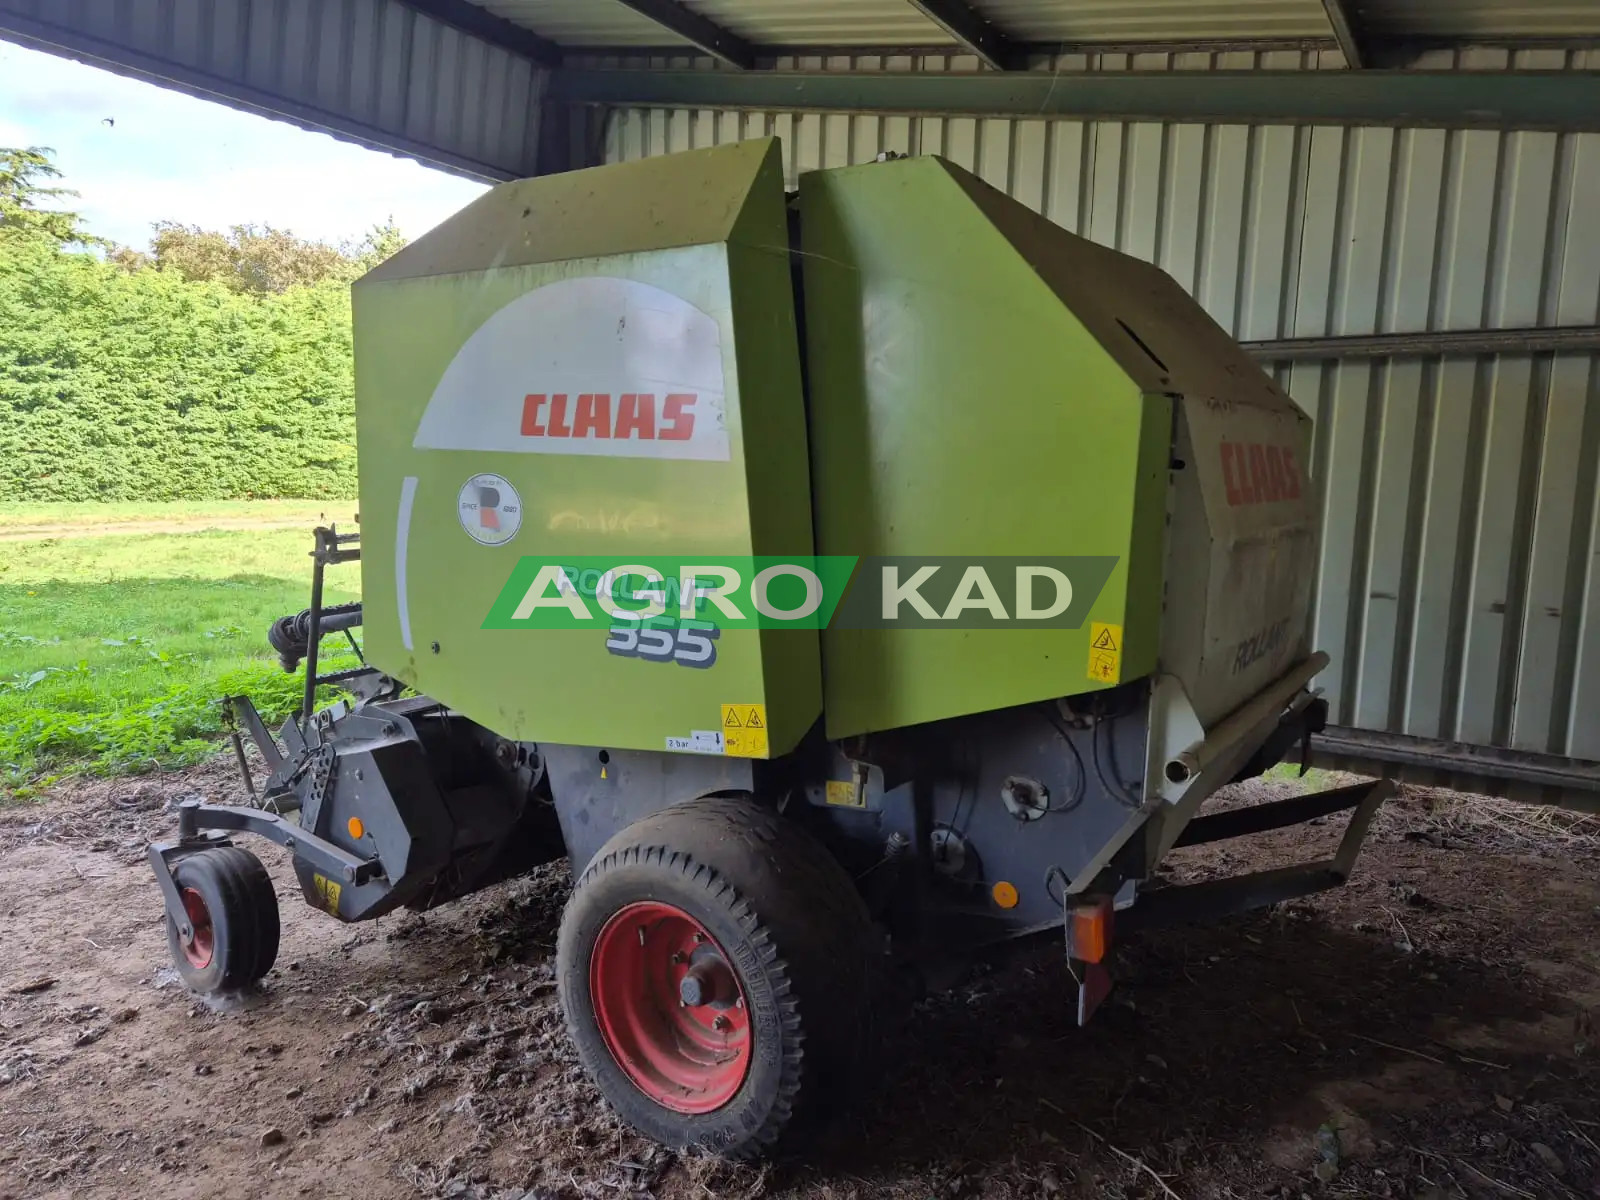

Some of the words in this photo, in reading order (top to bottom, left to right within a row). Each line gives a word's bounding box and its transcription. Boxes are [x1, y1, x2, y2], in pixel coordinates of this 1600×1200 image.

[520, 393, 698, 440] CLAAS
[1221, 444, 1301, 505] CLAAS
[556, 565, 718, 609] ROLLANT
[606, 607, 721, 669] 355
[676, 739, 689, 748] bar
